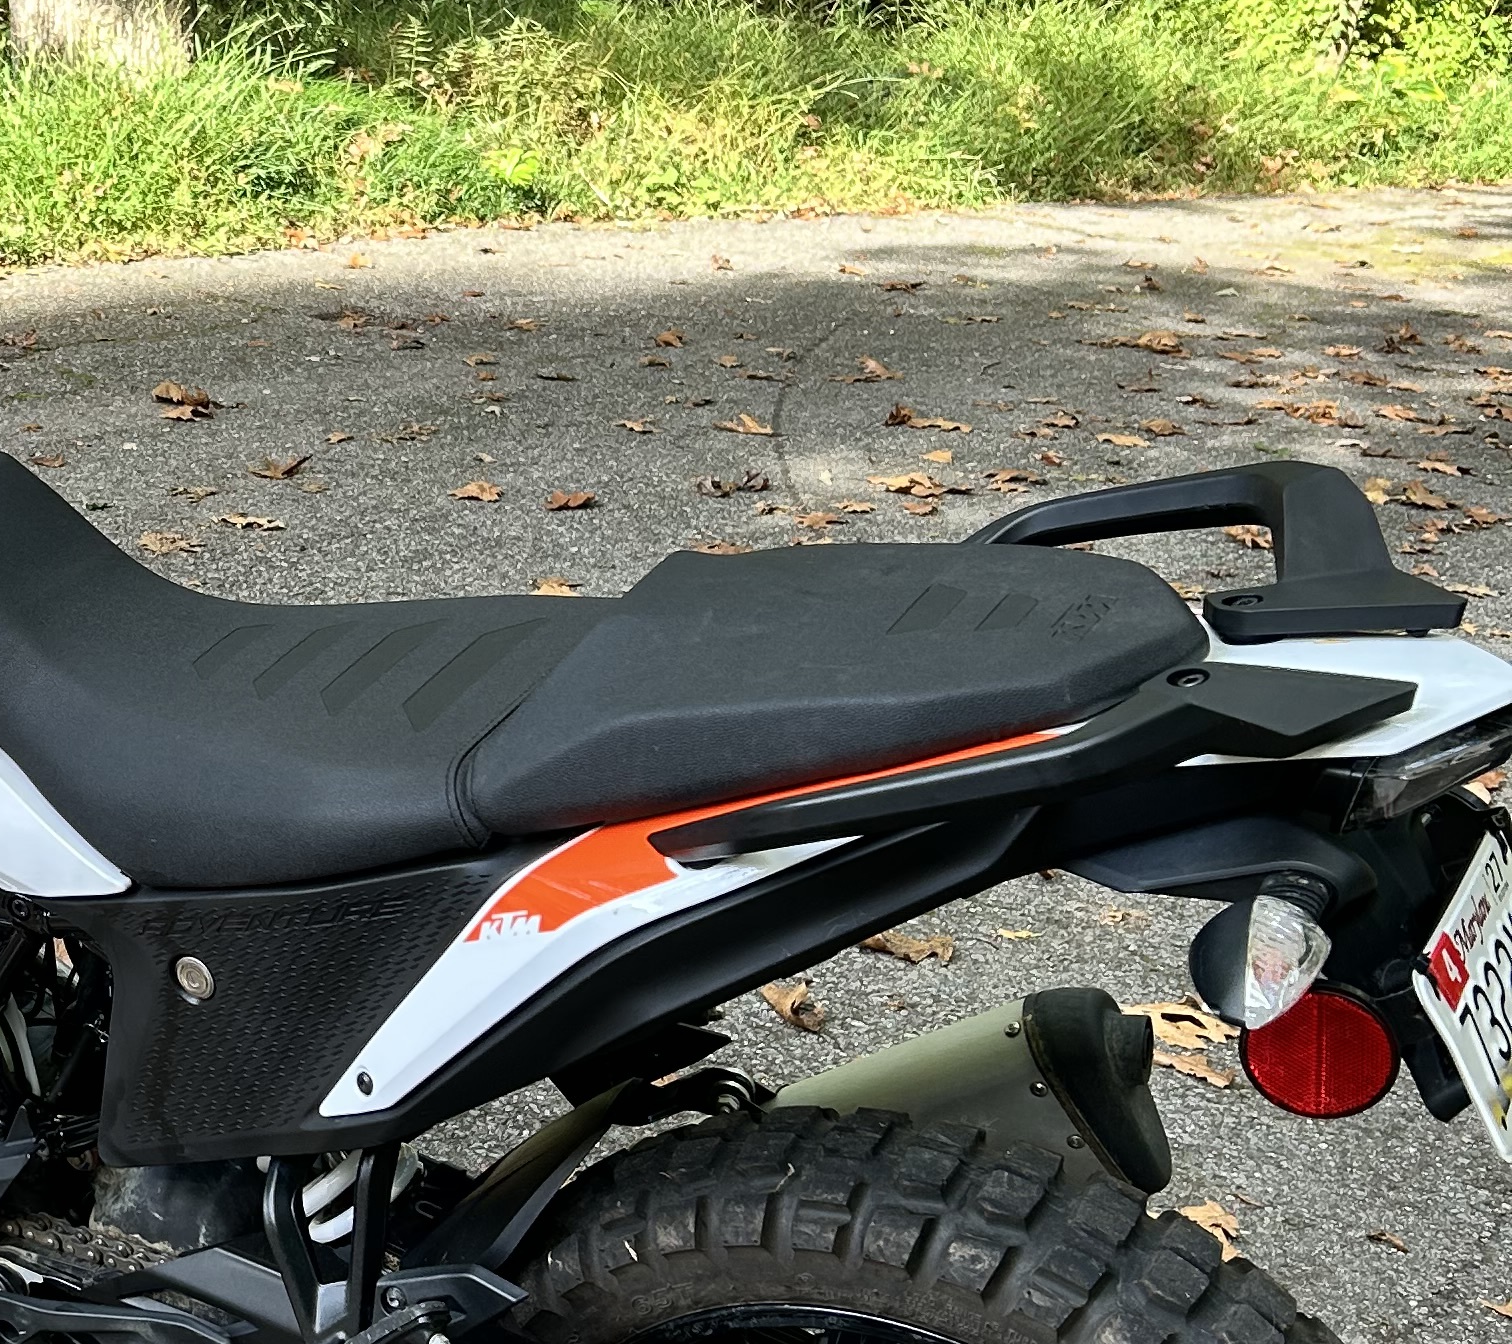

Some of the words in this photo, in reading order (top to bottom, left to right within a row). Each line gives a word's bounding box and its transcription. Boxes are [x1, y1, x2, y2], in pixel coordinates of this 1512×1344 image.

[1485, 851, 1504, 894] 27
[478, 910, 542, 941] KTM
[1441, 947, 1462, 984] 4
